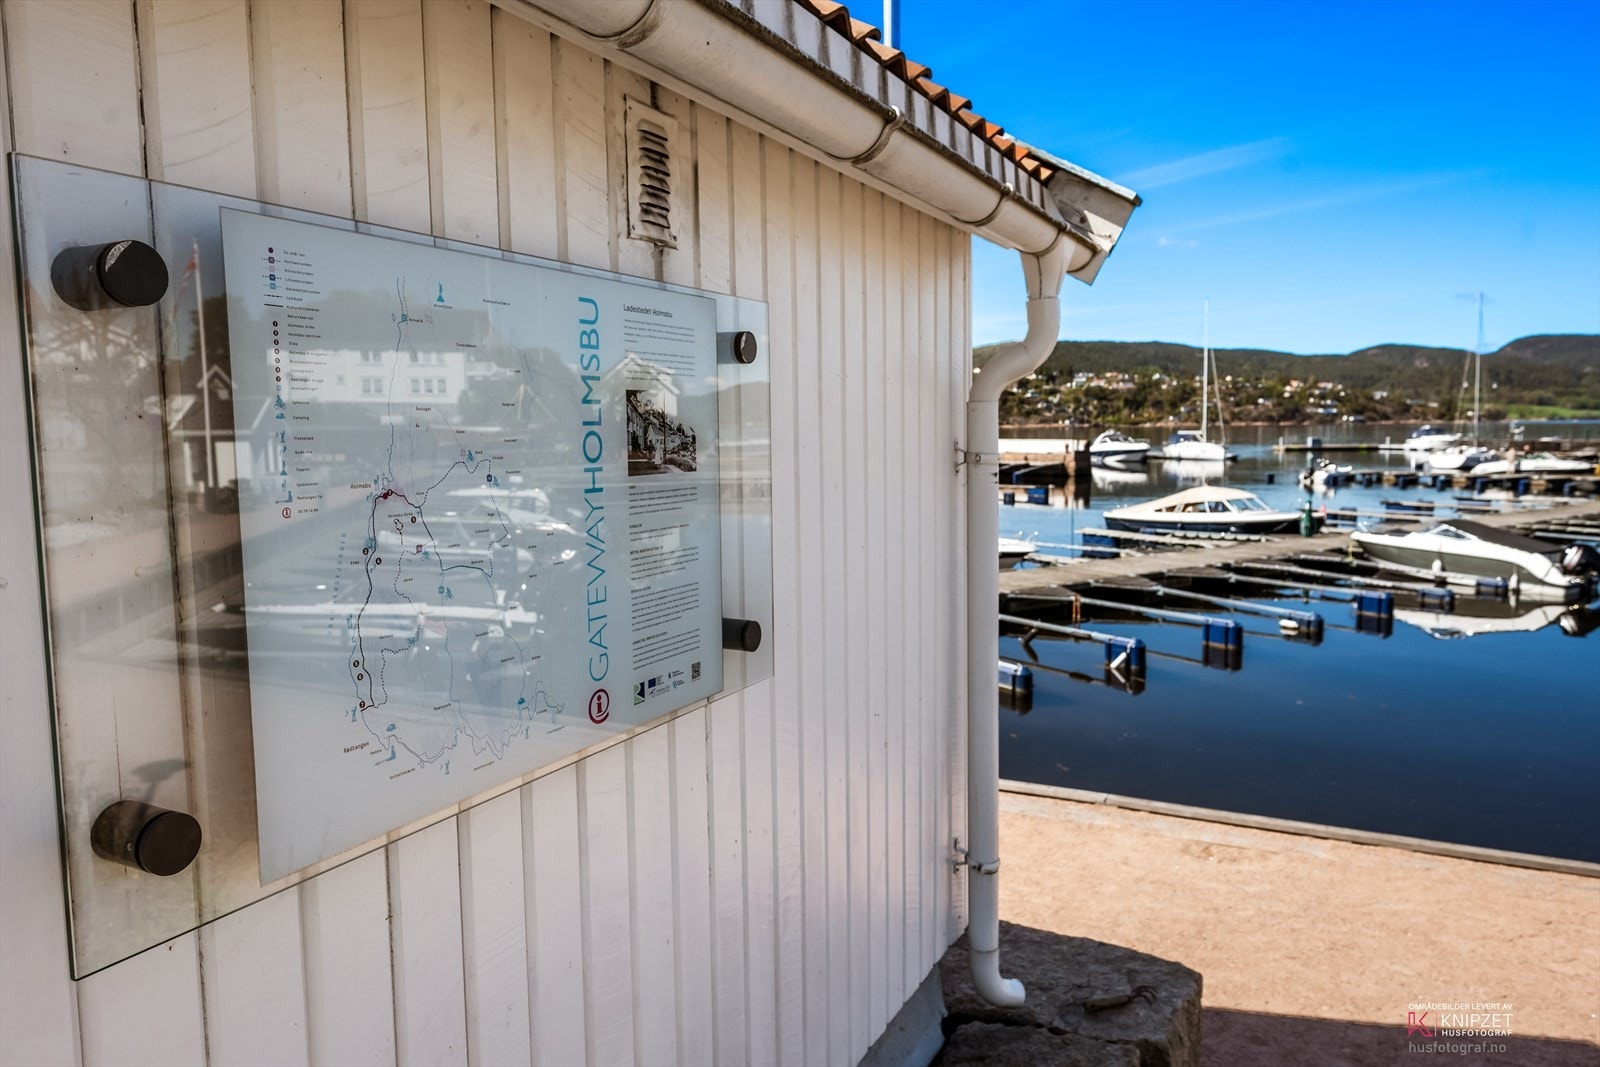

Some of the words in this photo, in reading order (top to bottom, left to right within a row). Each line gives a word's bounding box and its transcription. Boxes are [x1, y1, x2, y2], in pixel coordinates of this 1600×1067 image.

[623, 304, 652, 315] Ladestedet
[652, 308, 672, 318] Holmsbu
[344, 742, 369, 753] Rødtangen
